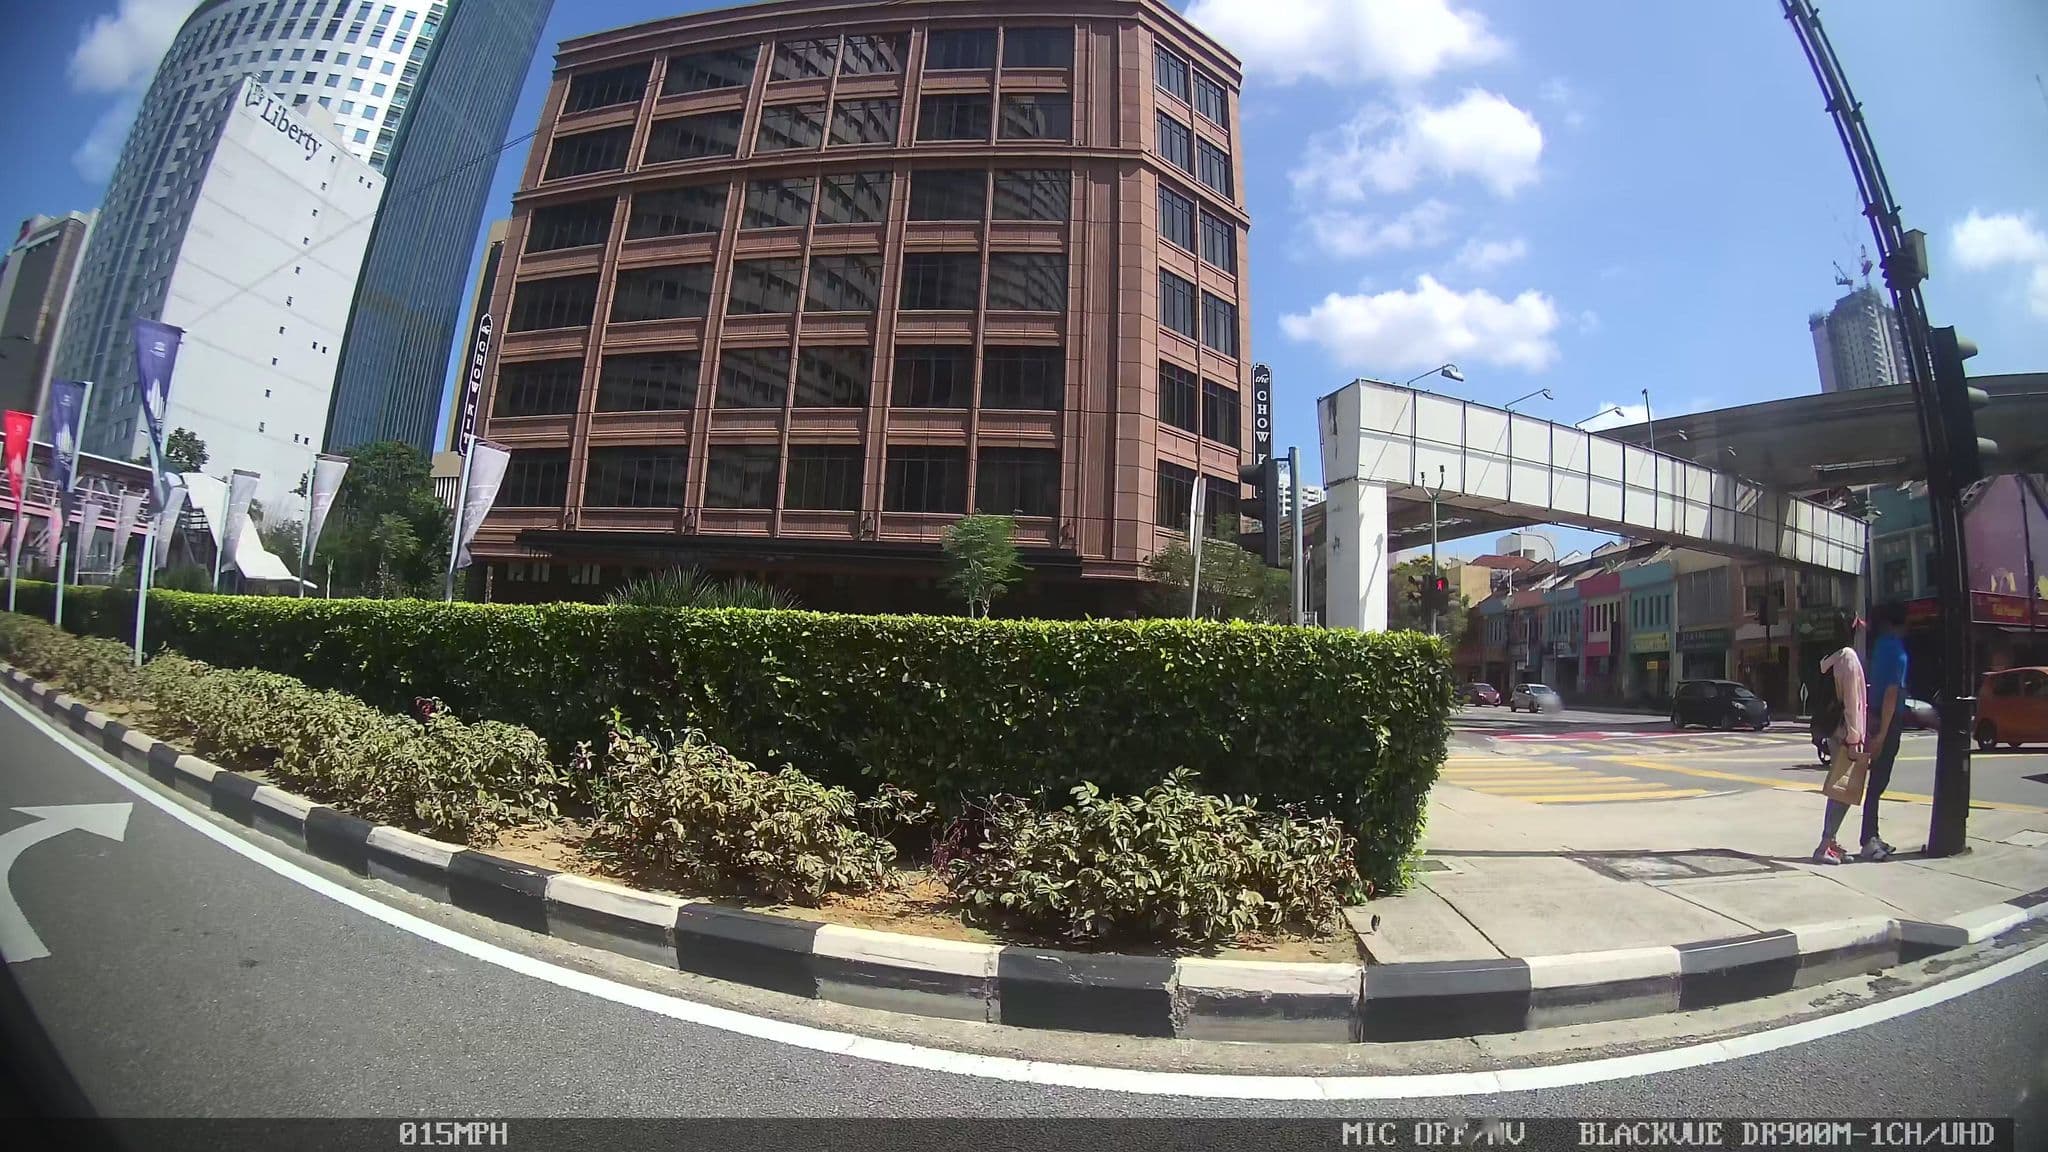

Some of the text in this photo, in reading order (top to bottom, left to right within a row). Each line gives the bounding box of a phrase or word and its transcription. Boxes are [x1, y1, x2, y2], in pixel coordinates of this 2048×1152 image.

[260, 98, 322, 161] Liberty
[470, 341, 486, 393] CHOW
[1255, 374, 1269, 383] the
[463, 403, 475, 444] KIT
[1255, 390, 1270, 442] CHOW
